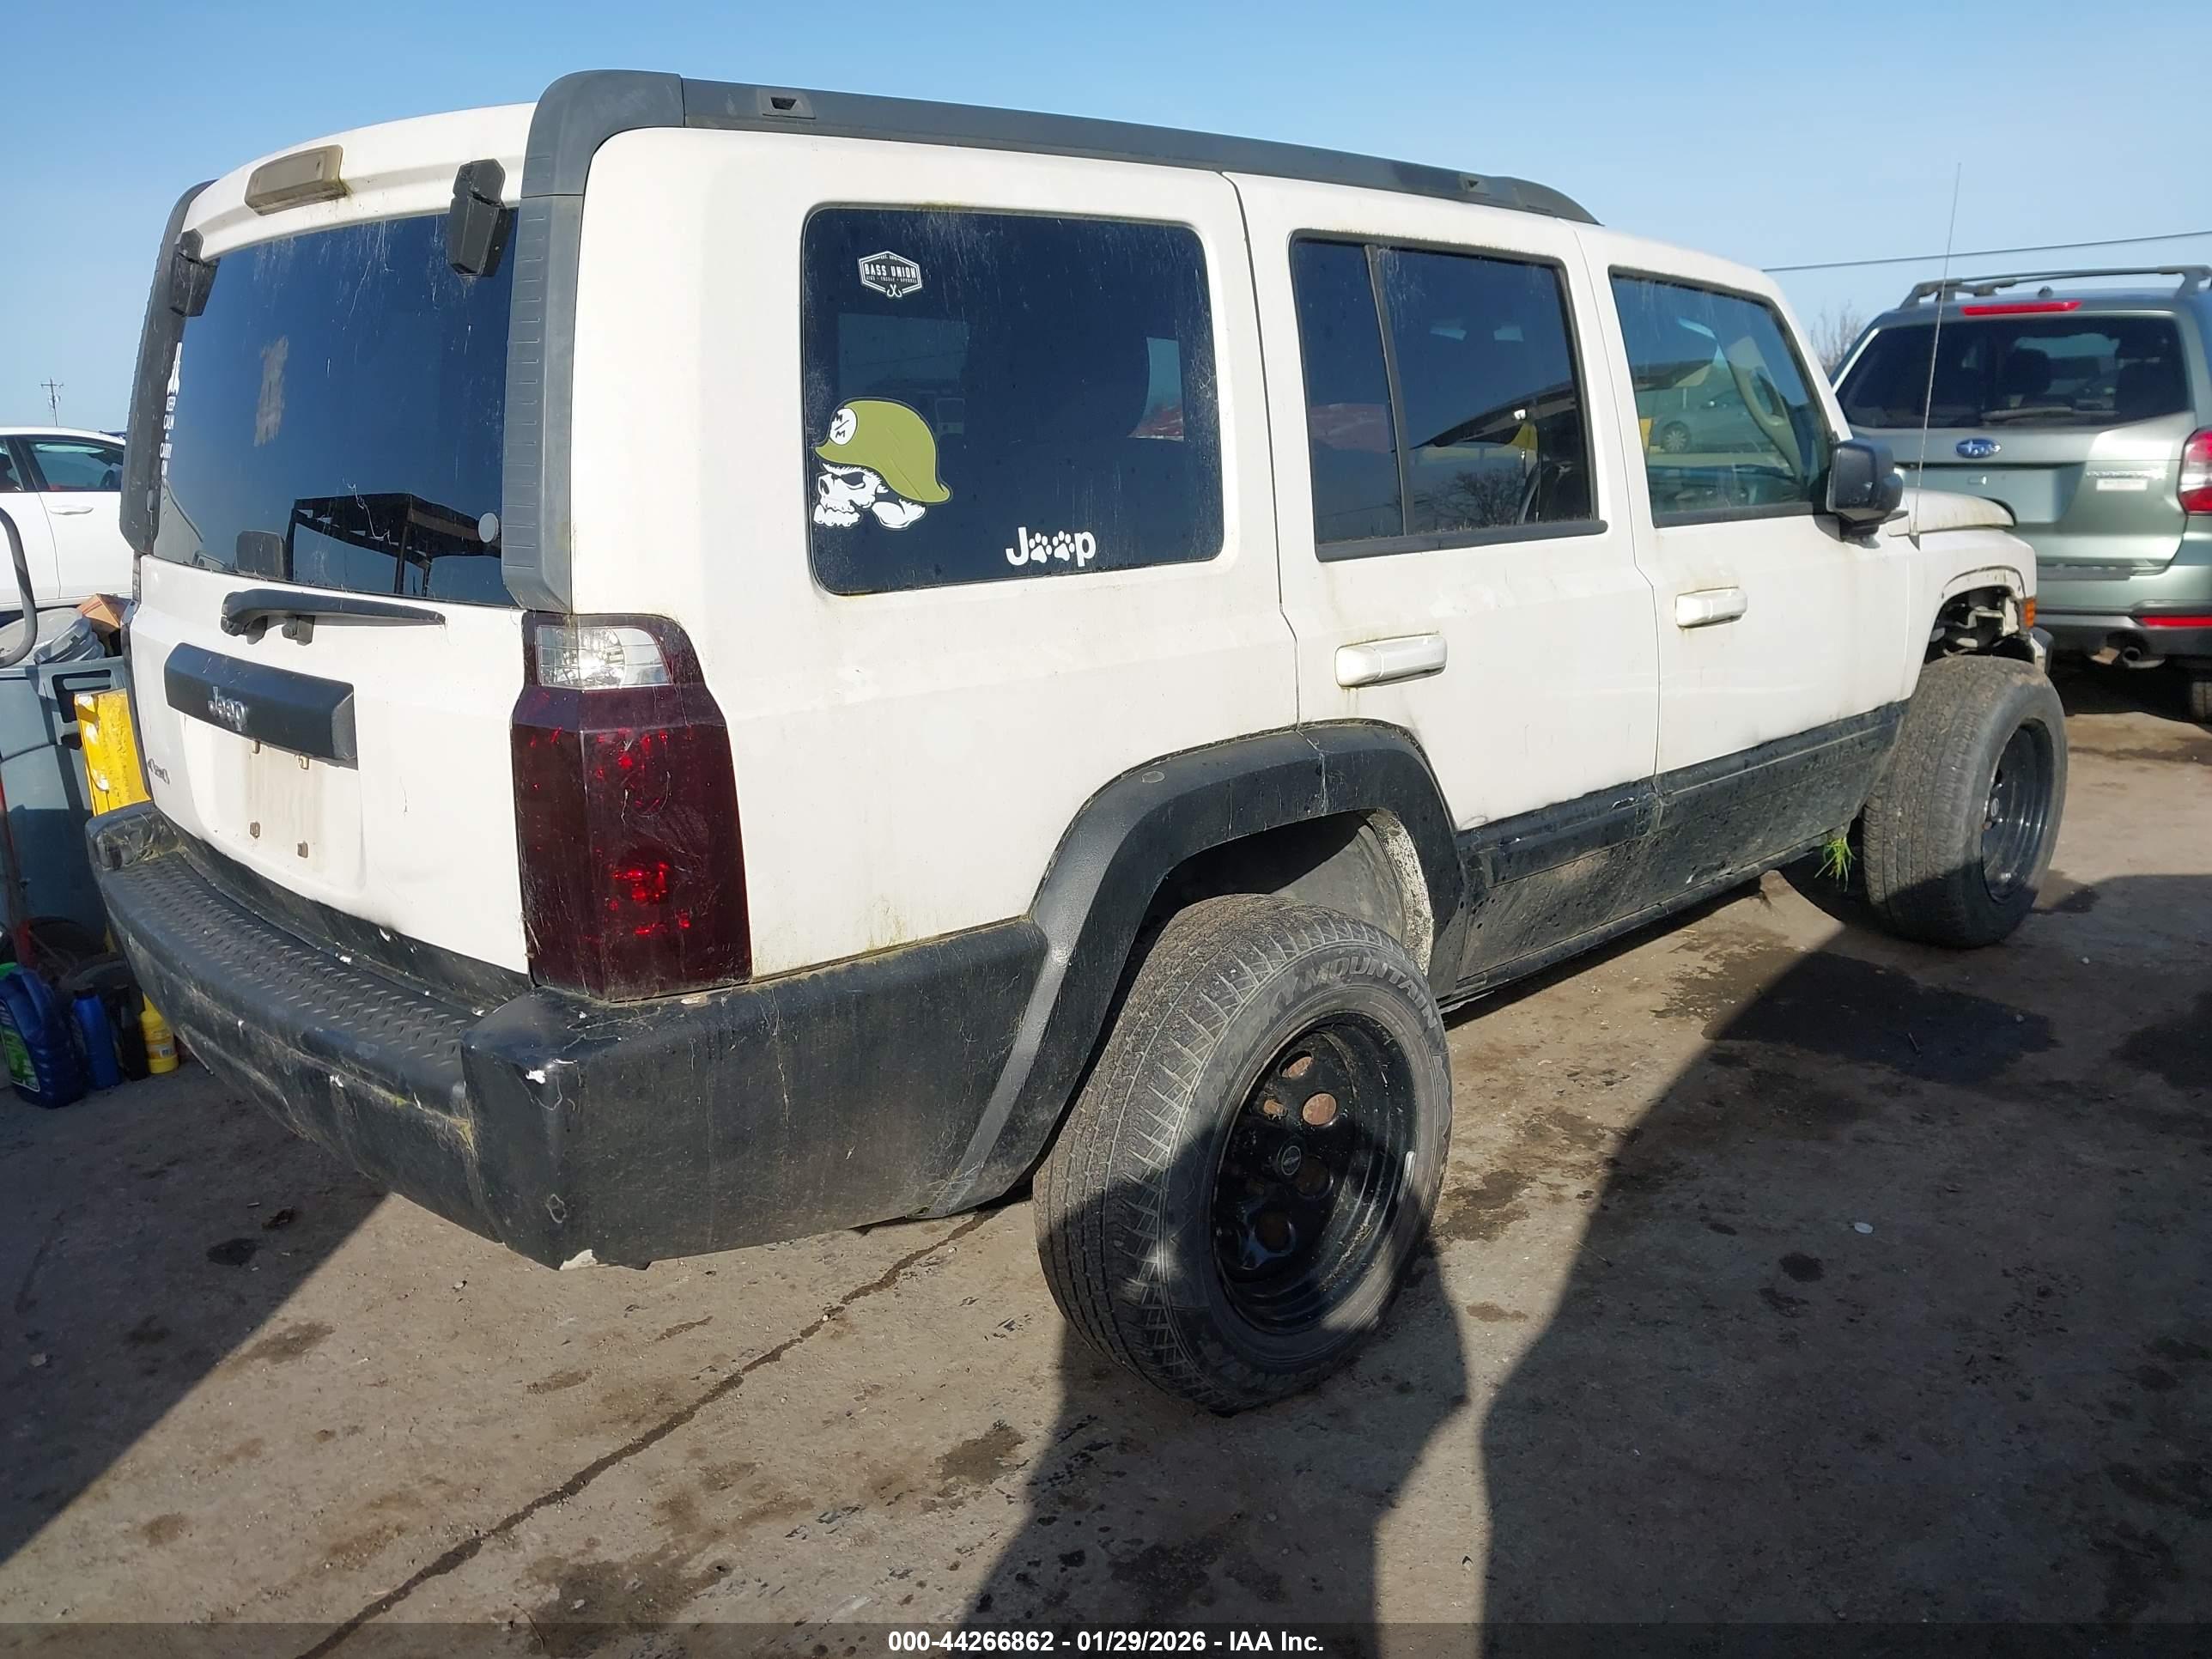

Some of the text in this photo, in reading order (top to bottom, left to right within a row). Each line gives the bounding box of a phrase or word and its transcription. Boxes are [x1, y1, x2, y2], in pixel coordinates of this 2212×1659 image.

[865, 264, 916, 277] BASS UNION
[163, 414, 175, 430] CALM
[1006, 526, 1097, 567] Jp
[208, 686, 248, 732] Jeep
[1304, 955, 1438, 1029] MOUNTAIN
